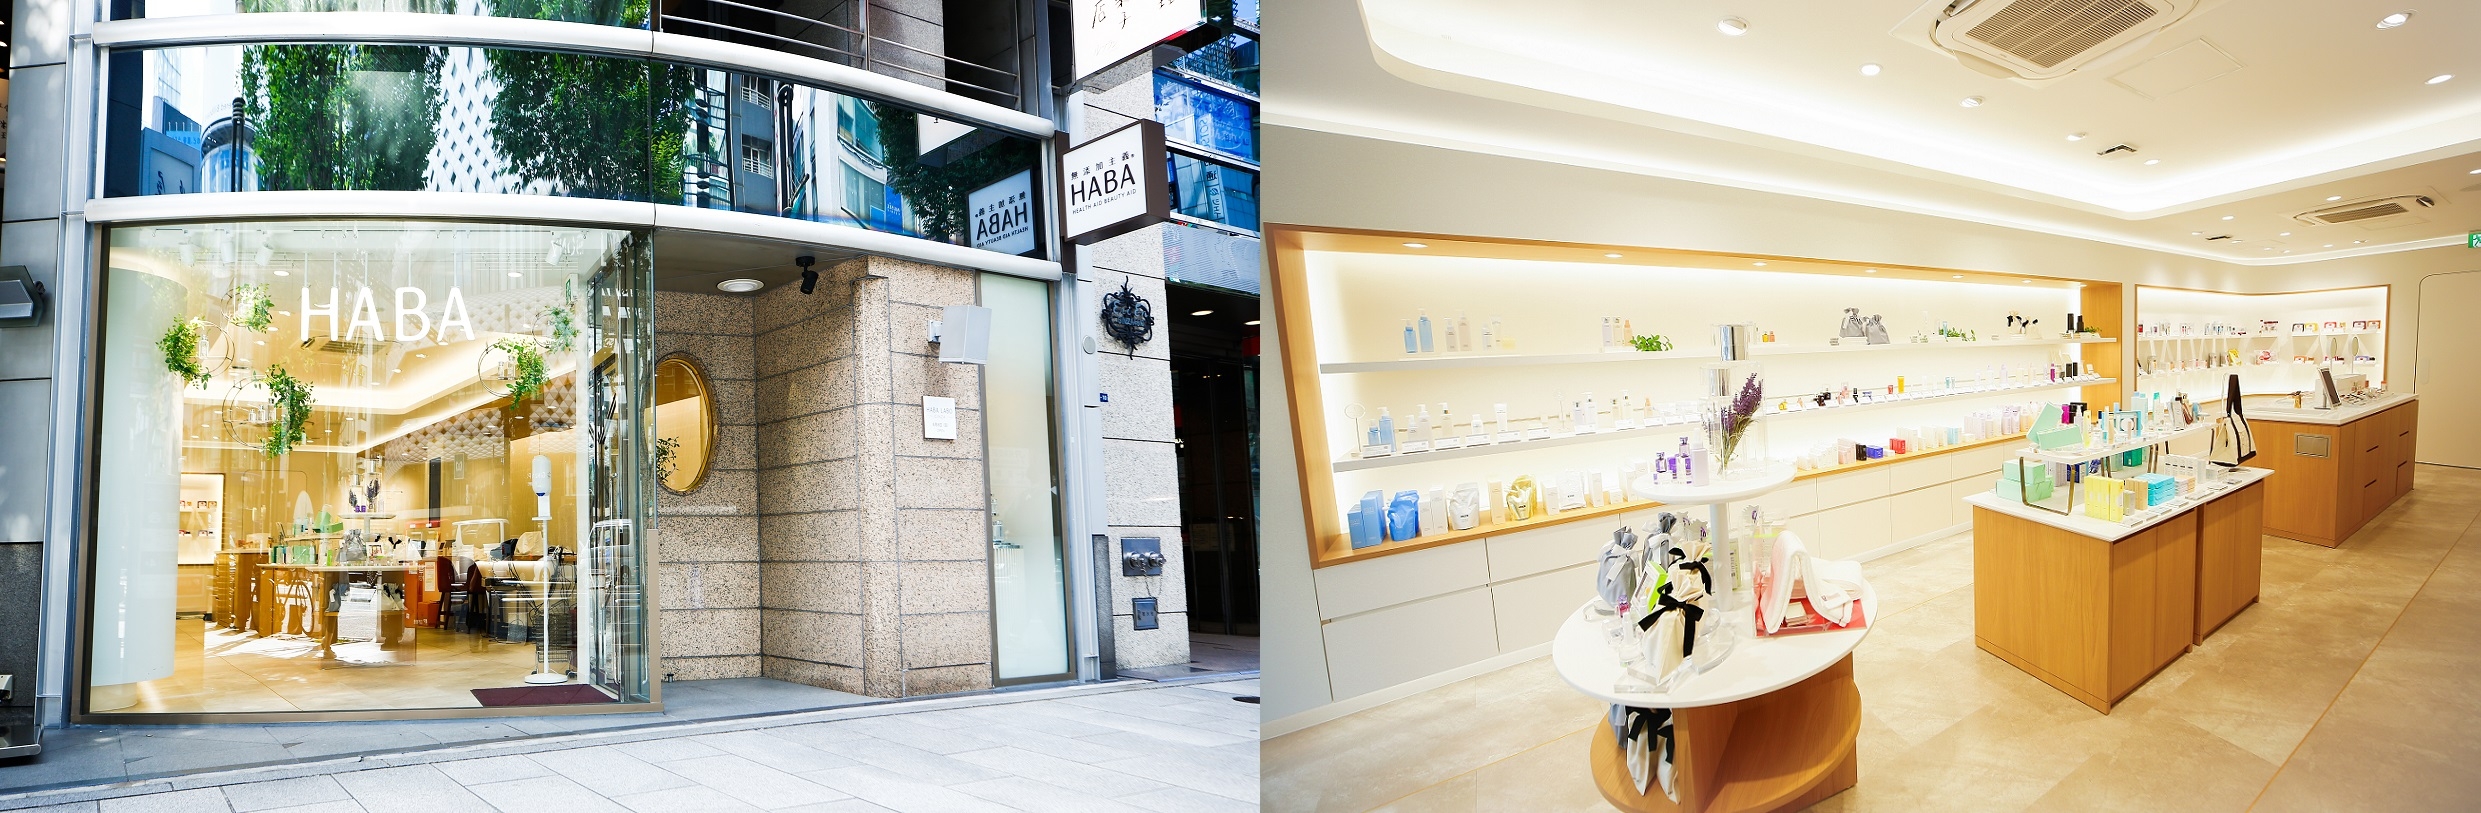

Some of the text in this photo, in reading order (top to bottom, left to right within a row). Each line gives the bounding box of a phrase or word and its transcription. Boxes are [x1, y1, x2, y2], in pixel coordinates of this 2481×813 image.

[1071, 164, 1135, 206] HABA
[1072, 188, 1137, 215] HEALTH AID BEAUTY AID
[301, 286, 476, 342] HABA
